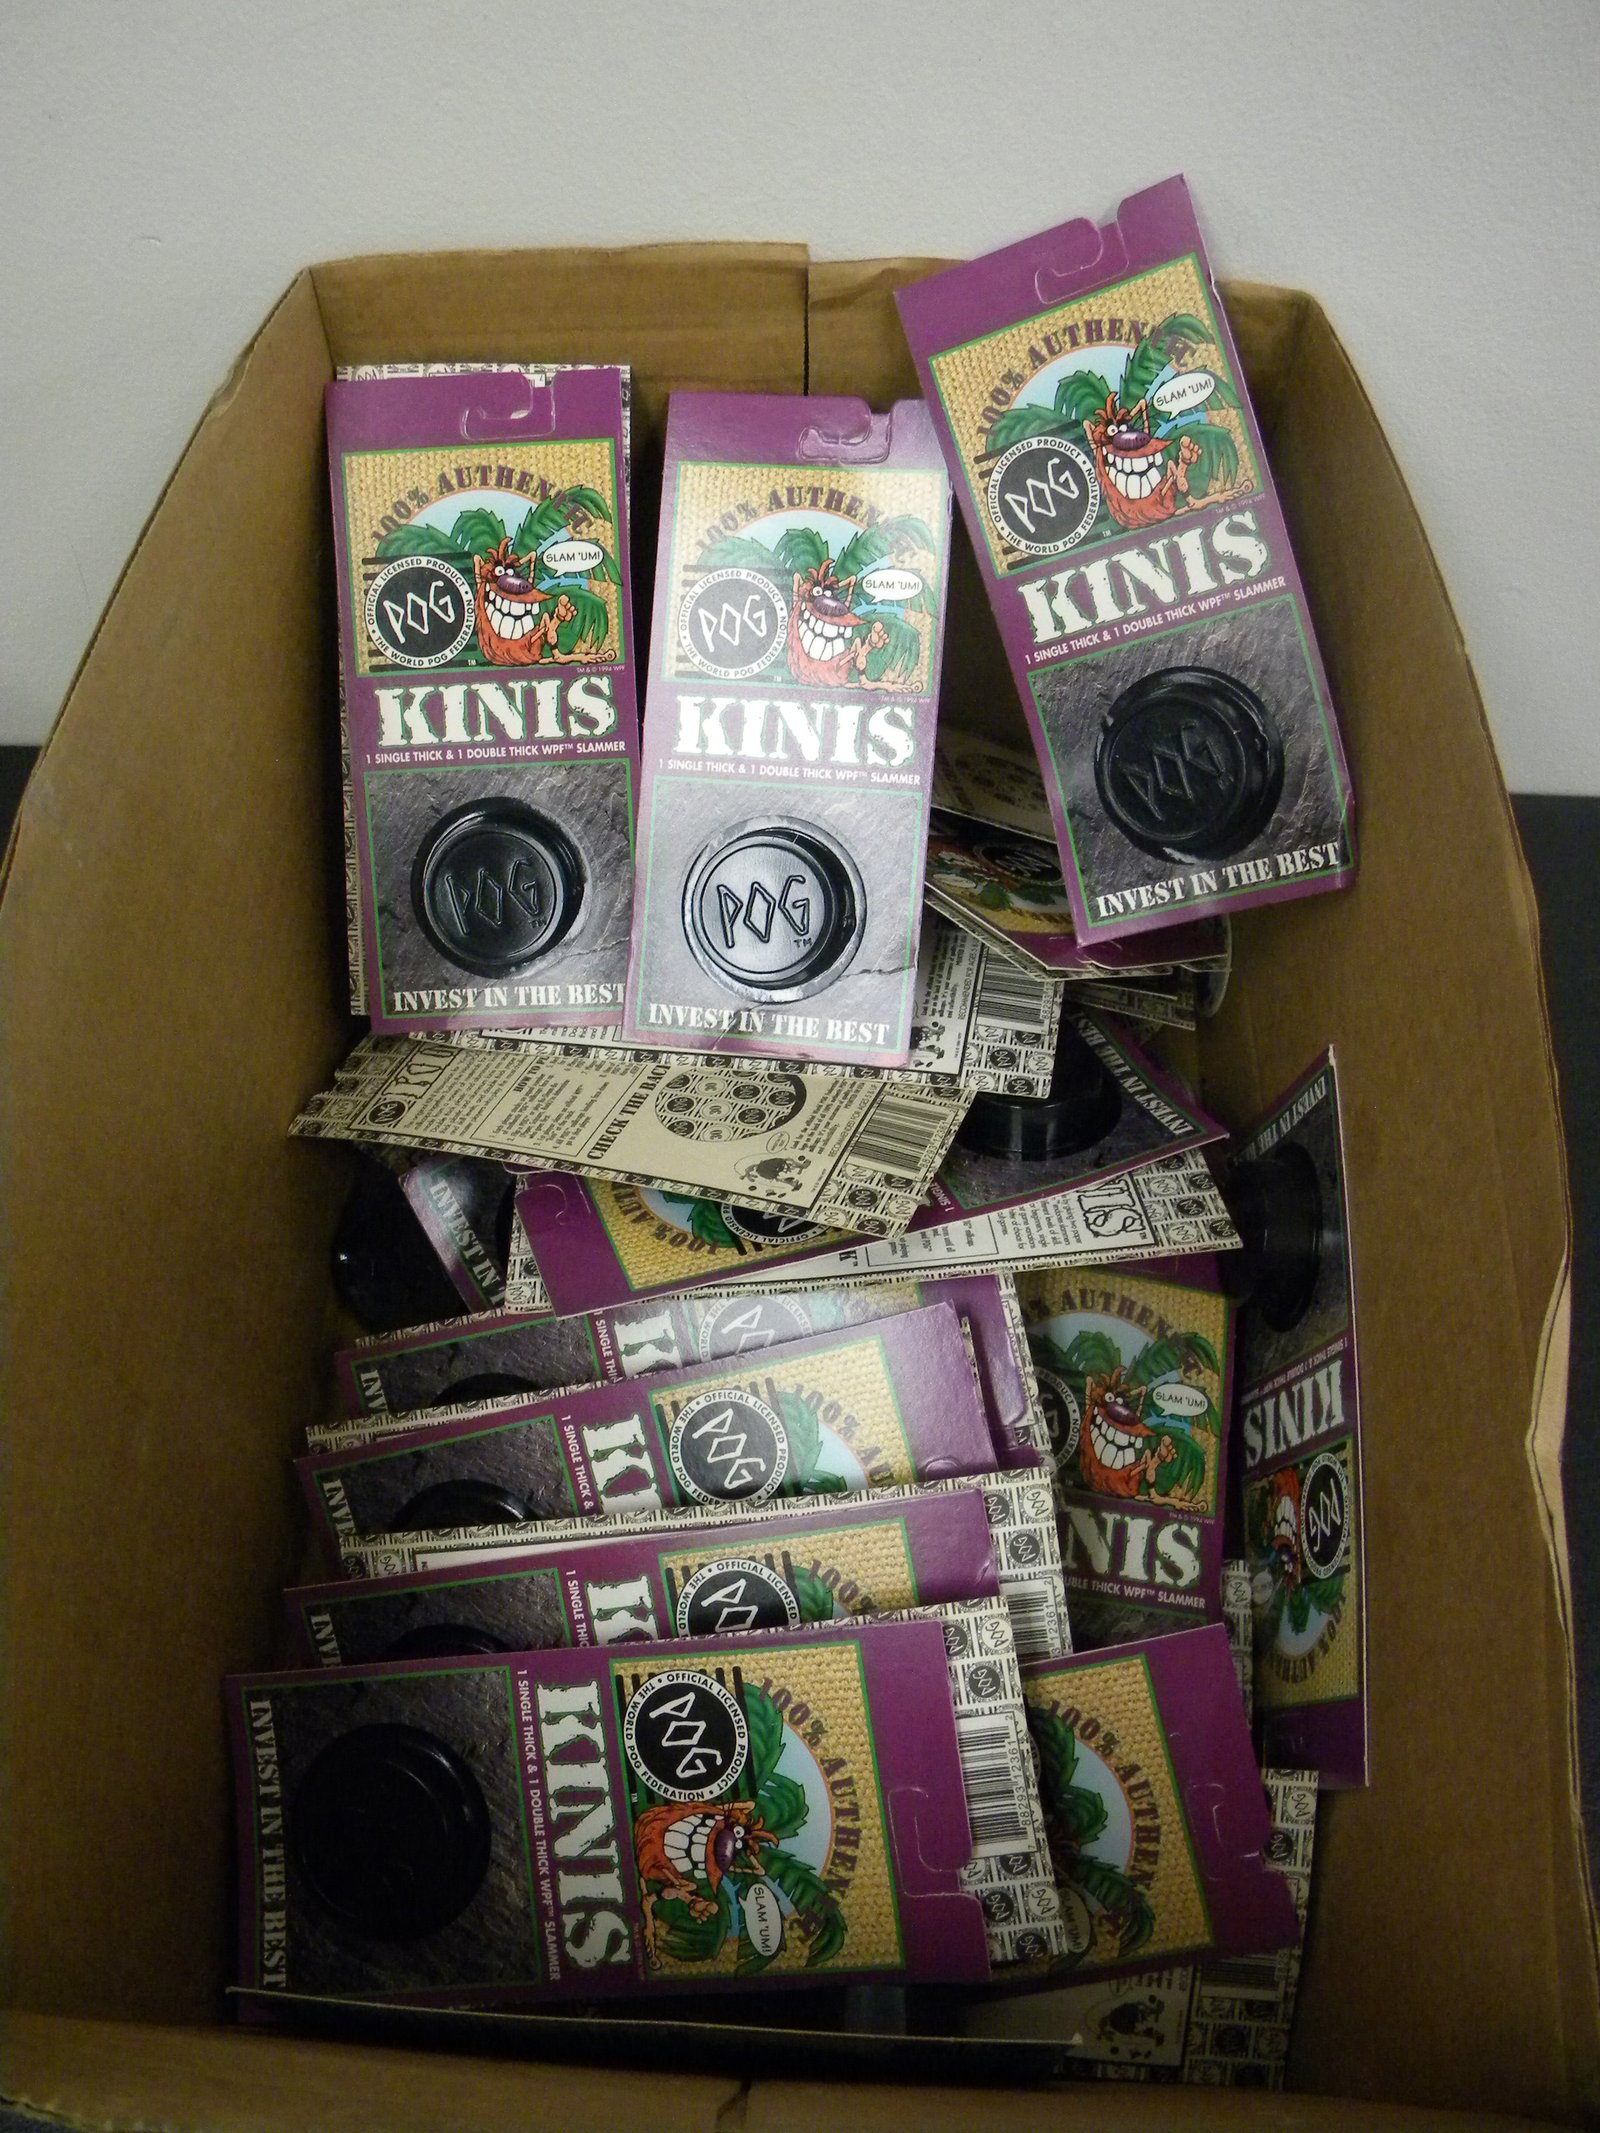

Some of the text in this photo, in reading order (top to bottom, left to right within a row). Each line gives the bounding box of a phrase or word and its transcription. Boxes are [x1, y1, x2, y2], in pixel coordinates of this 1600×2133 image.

[1155, 389, 1187, 407] SLAM
[990, 439, 1081, 523] OFFICIAL LICENSED PRODUCT
[1004, 457, 1079, 533] POG
[1005, 468, 1098, 554] THE WORLD POG FEDERATION
[546, 553, 575, 563] SLAM
[865, 579, 894, 590] SLAM
[1018, 512, 1268, 644] KINIS
[367, 558, 466, 625] OFFICIAL LICENSED PRODUCT
[383, 580, 456, 644] POG
[680, 570, 782, 631] OFFICIAL LICENSED PRODUCT
[1034, 644, 1069, 663] SINGLE
[1069, 633, 1100, 651] THICK
[1103, 631, 1111, 641] &
[1123, 614, 1164, 635] DOUBLE
[1165, 604, 1196, 622] THICK
[1234, 576, 1286, 601] SLAMMER
[375, 599, 474, 666] THE WORLD POG FEDERATION
[685, 616, 787, 677] THE WORLD POG FEDERATION
[698, 595, 767, 653] POG
[374, 675, 616, 748] KINIS
[674, 695, 914, 767] KINIS
[375, 753, 411, 764] SINGLE
[413, 751, 443, 762] THICK
[446, 750, 454, 760] &
[467, 748, 506, 759] DOUBLE
[509, 746, 539, 757] THICK
[576, 741, 626, 753] SLAMMER
[667, 759, 703, 771] SINGLE
[705, 762, 735, 773] THICK
[738, 764, 746, 774] &
[759, 765, 799, 777] DOUBLE
[802, 768, 831, 780] THICK
[870, 773, 920, 785] SLAMMER
[1097, 842, 1339, 918] INVEST IN THE BEST
[717, 874, 810, 949] POG
[792, 938, 812, 948] TM
[393, 983, 625, 1011] INVEST IN THE BEST
[648, 1003, 890, 1045] INVEST IN THE BEST
[513, 1064, 541, 1093] HOW TO
[1094, 1046, 1194, 1136] INVEST IN THE
[1294, 1075, 1326, 1125] INVEST
[587, 1118, 629, 1160] CHECK
[619, 1091, 650, 1116] THE
[430, 1179, 500, 1288] INVEST IN
[724, 1216, 809, 1243] OFFICIAL LICENSED
[595, 1320, 612, 1358] SINGLE
[700, 1323, 713, 1358] WORLD
[1155, 1392, 1183, 1404] SLAM
[1244, 1360, 1345, 1468] KINIS
[563, 1424, 594, 1510] SINGLE THICK &
[671, 1406, 694, 1488] THE WORLD POG
[691, 1408, 766, 1489] POG
[704, 1391, 786, 1494] OFFICIAL LICENSED PRODUCT
[1308, 1478, 1341, 1553] POG
[1062, 1507, 1200, 1587] NIS
[567, 1580, 584, 1618] SINGLE
[679, 1572, 707, 1629] THE WORLD
[701, 1578, 758, 1633] PO
[717, 1561, 797, 1619] OFFICIAL LICENSED
[1091, 1580, 1206, 1608] THICK SLAMMER
[1047, 1603, 1058, 1644] 12361
[518, 1680, 532, 1722] SINGLE
[760, 1676, 828, 1747] 100%
[1049, 1699, 1120, 1757] 100%
[522, 1724, 536, 1763] THICK
[626, 1683, 704, 1800] THE WORLD POG FEDERATION
[649, 1692, 722, 1778] POG
[667, 1673, 746, 1791] OFFICIAL LICENSED PRODUCT
[527, 1764, 538, 1774] &
[1010, 1740, 1031, 1826] 88293 12361
[530, 1789, 545, 1837] DOUBLE
[536, 1680, 630, 1968] KINIS
[250, 1700, 286, 1988] INVEST IN THE BEST
[535, 1838, 549, 1876] THICK
[753, 1887, 770, 1921] SLAM
[544, 1921, 561, 1981] SLAMMER
